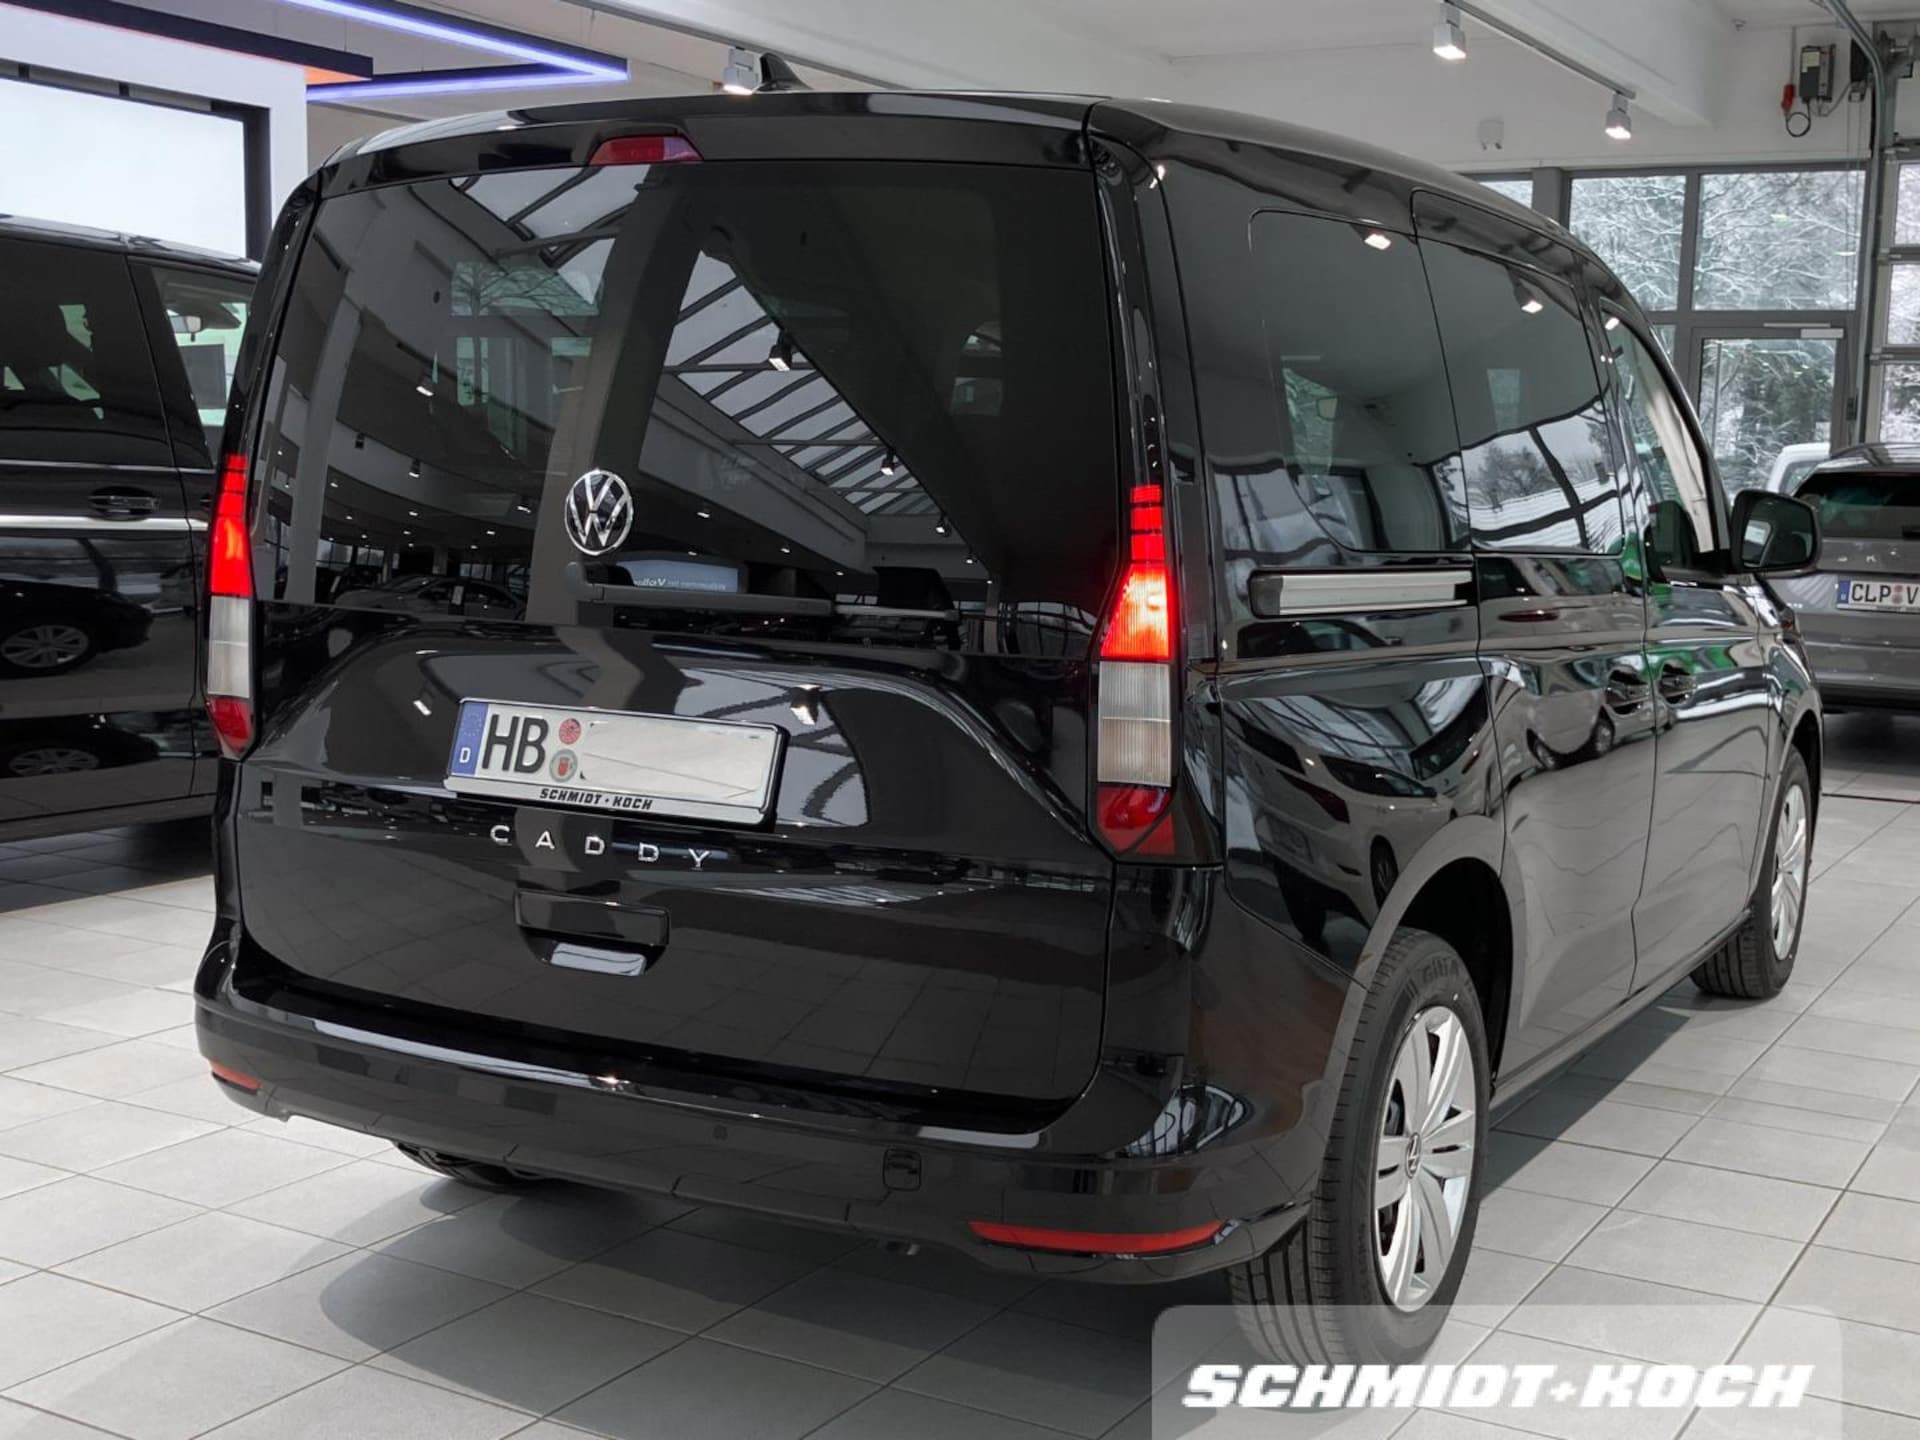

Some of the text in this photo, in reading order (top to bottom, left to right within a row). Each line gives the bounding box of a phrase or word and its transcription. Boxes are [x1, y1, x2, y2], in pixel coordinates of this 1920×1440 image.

[1851, 583, 1892, 603] CLP
[459, 746, 471, 764] D
[481, 713, 550, 774] HB
[539, 787, 602, 805] SCHMIDT
[612, 796, 654, 811] KOCH
[489, 824, 711, 869] CADDY
